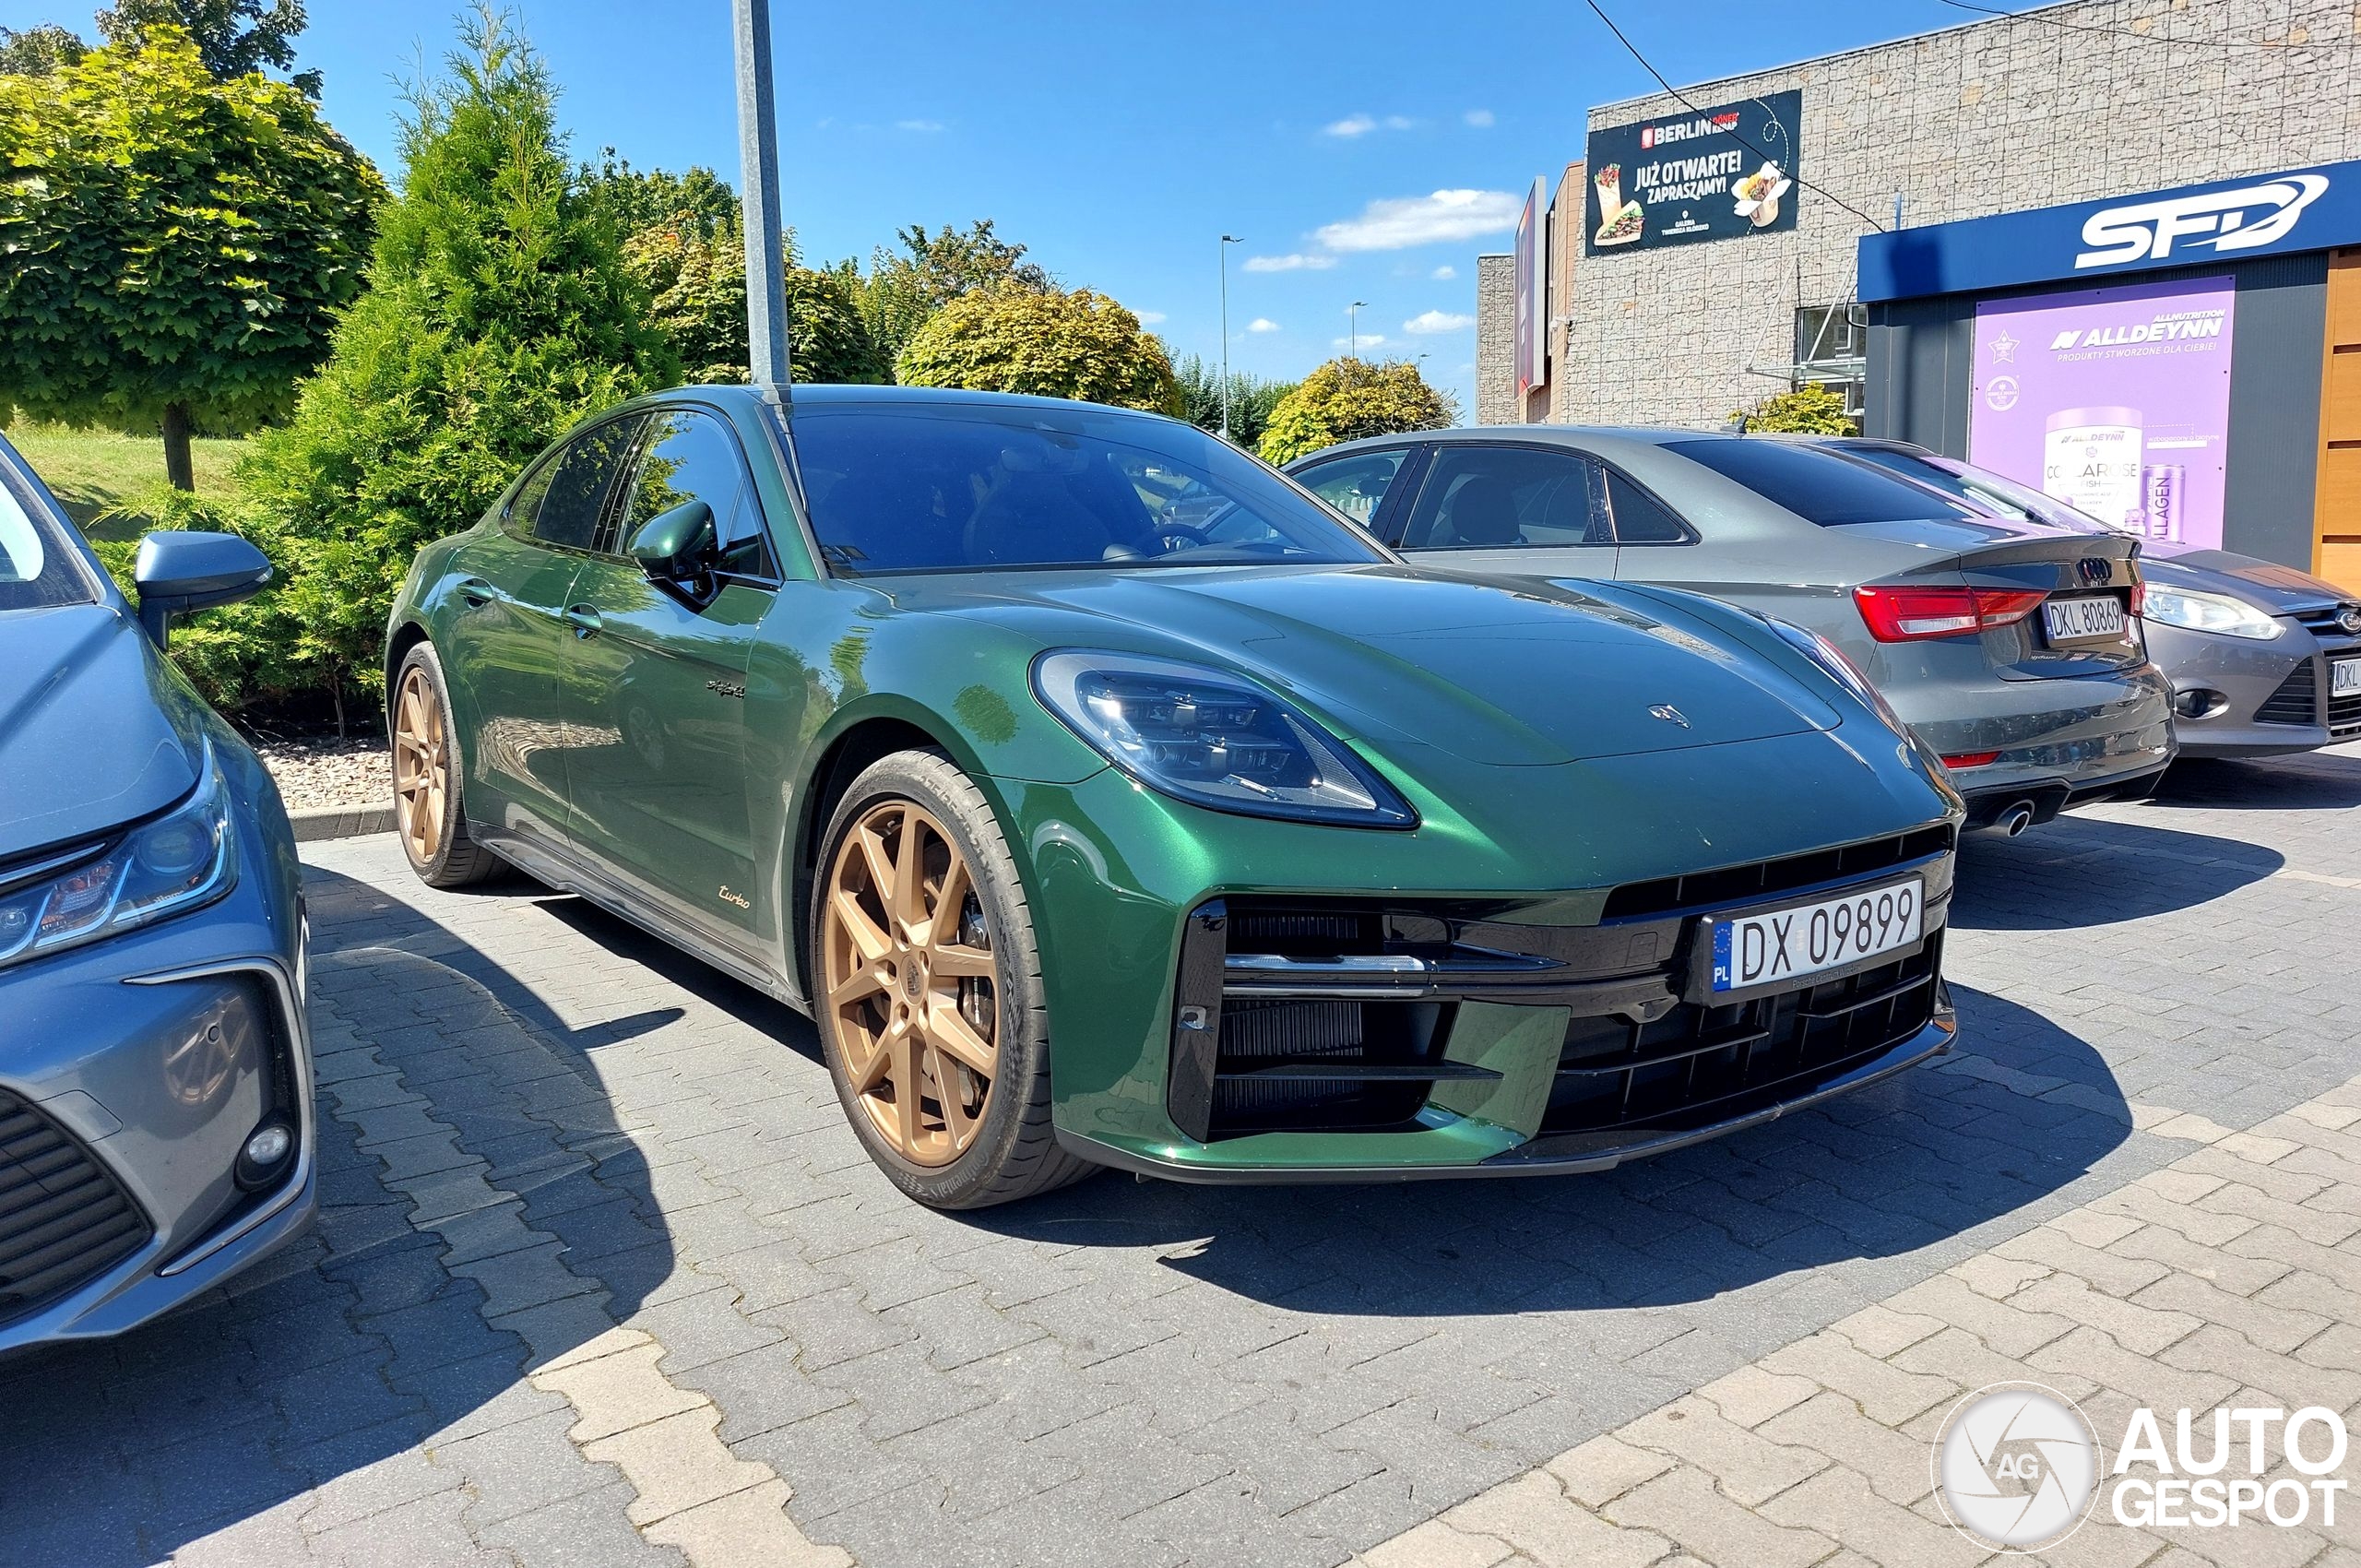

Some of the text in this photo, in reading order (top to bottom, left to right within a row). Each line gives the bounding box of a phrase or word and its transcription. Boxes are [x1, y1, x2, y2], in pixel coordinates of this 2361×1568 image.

[1655, 119, 1712, 146] BERLIN
[1634, 149, 1742, 192] JUŻ OTWARTE!
[1647, 177, 1726, 205] ZAPRASZAMY!
[2074, 174, 2330, 269] SFD
[2153, 309, 2226, 323] ALLNUTRITION
[2081, 317, 2225, 348] ALLDEYNN
[2057, 341, 2217, 362] PRODUKTY STWORZONE DLA CIEBIE!
[2047, 463, 2138, 480] COAROSE
[2153, 477, 2170, 540] LLAGEN
[2050, 600, 2120, 636] DKL 80869
[2340, 663, 2358, 688] DKL
[1742, 888, 1913, 982] DX 09899
[1714, 966, 1729, 983] PL
